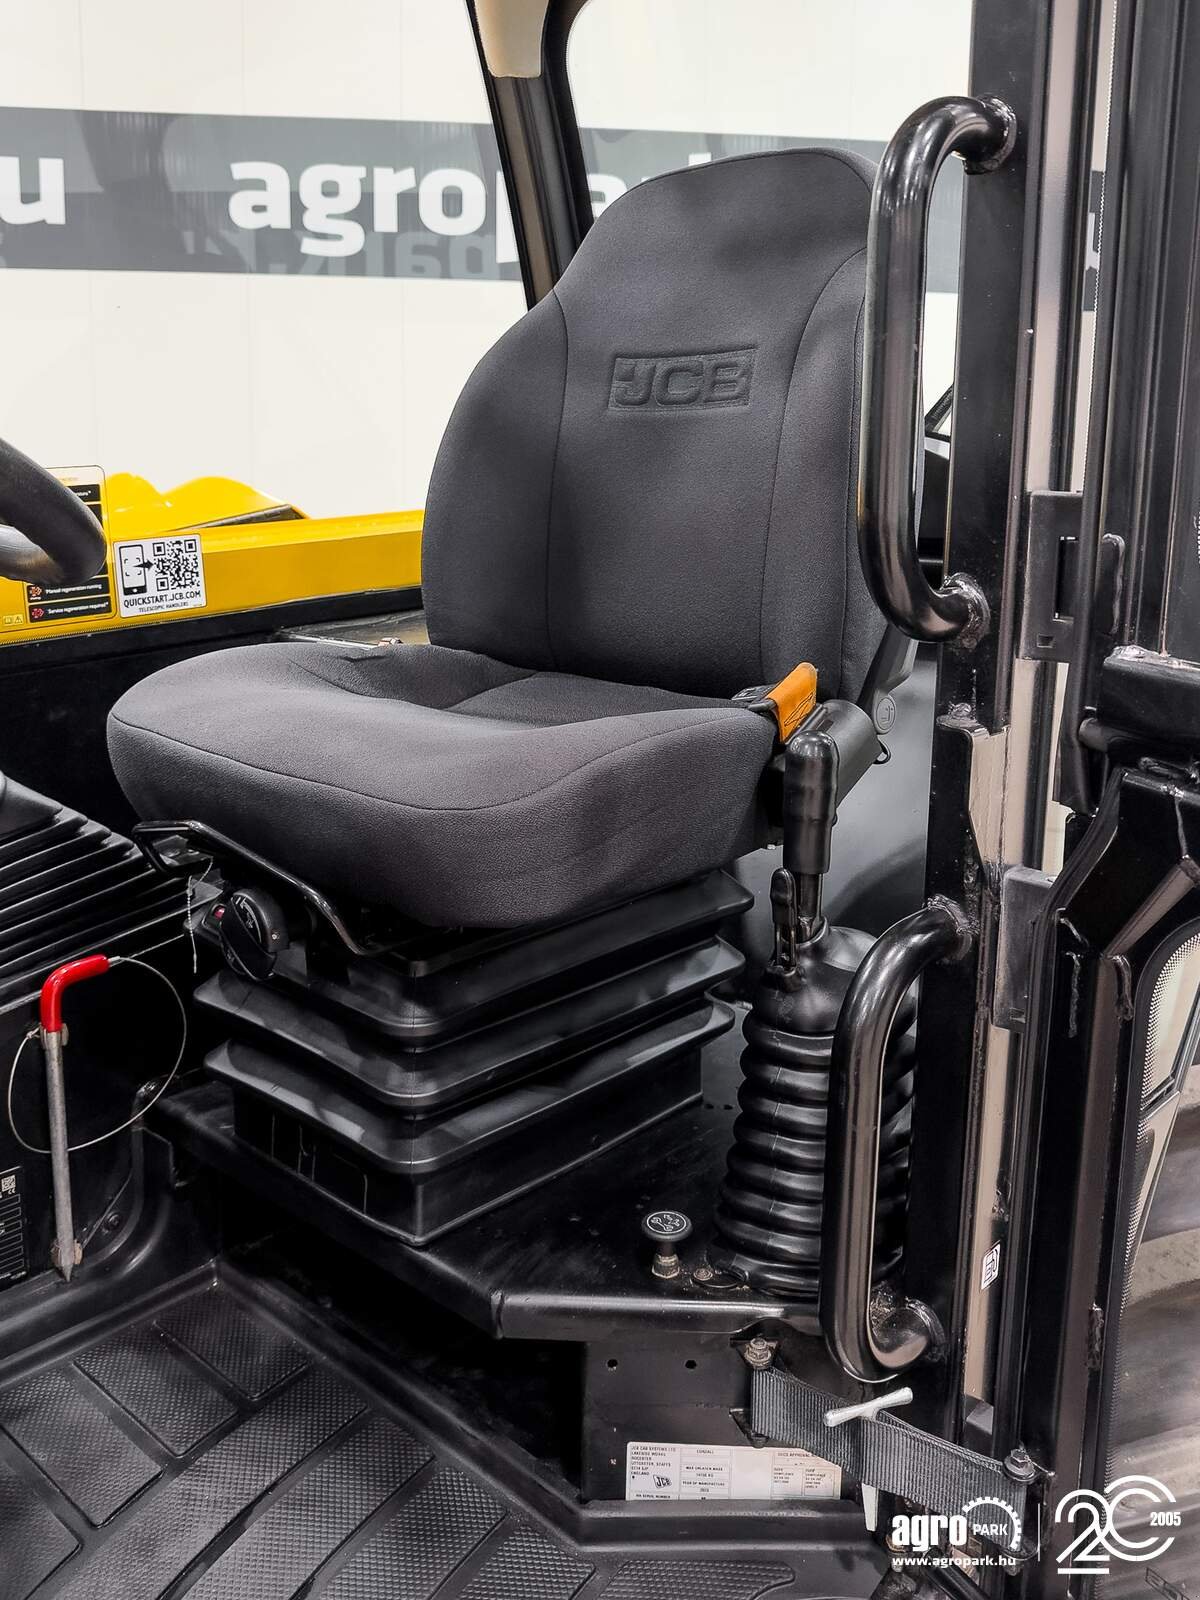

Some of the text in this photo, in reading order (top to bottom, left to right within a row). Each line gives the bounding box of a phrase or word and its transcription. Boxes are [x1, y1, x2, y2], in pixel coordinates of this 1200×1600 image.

[613, 356, 750, 407] JCB
[123, 590, 202, 608] QUICKSTART.JCB.COM
[655, 1476, 671, 1487] JCB
